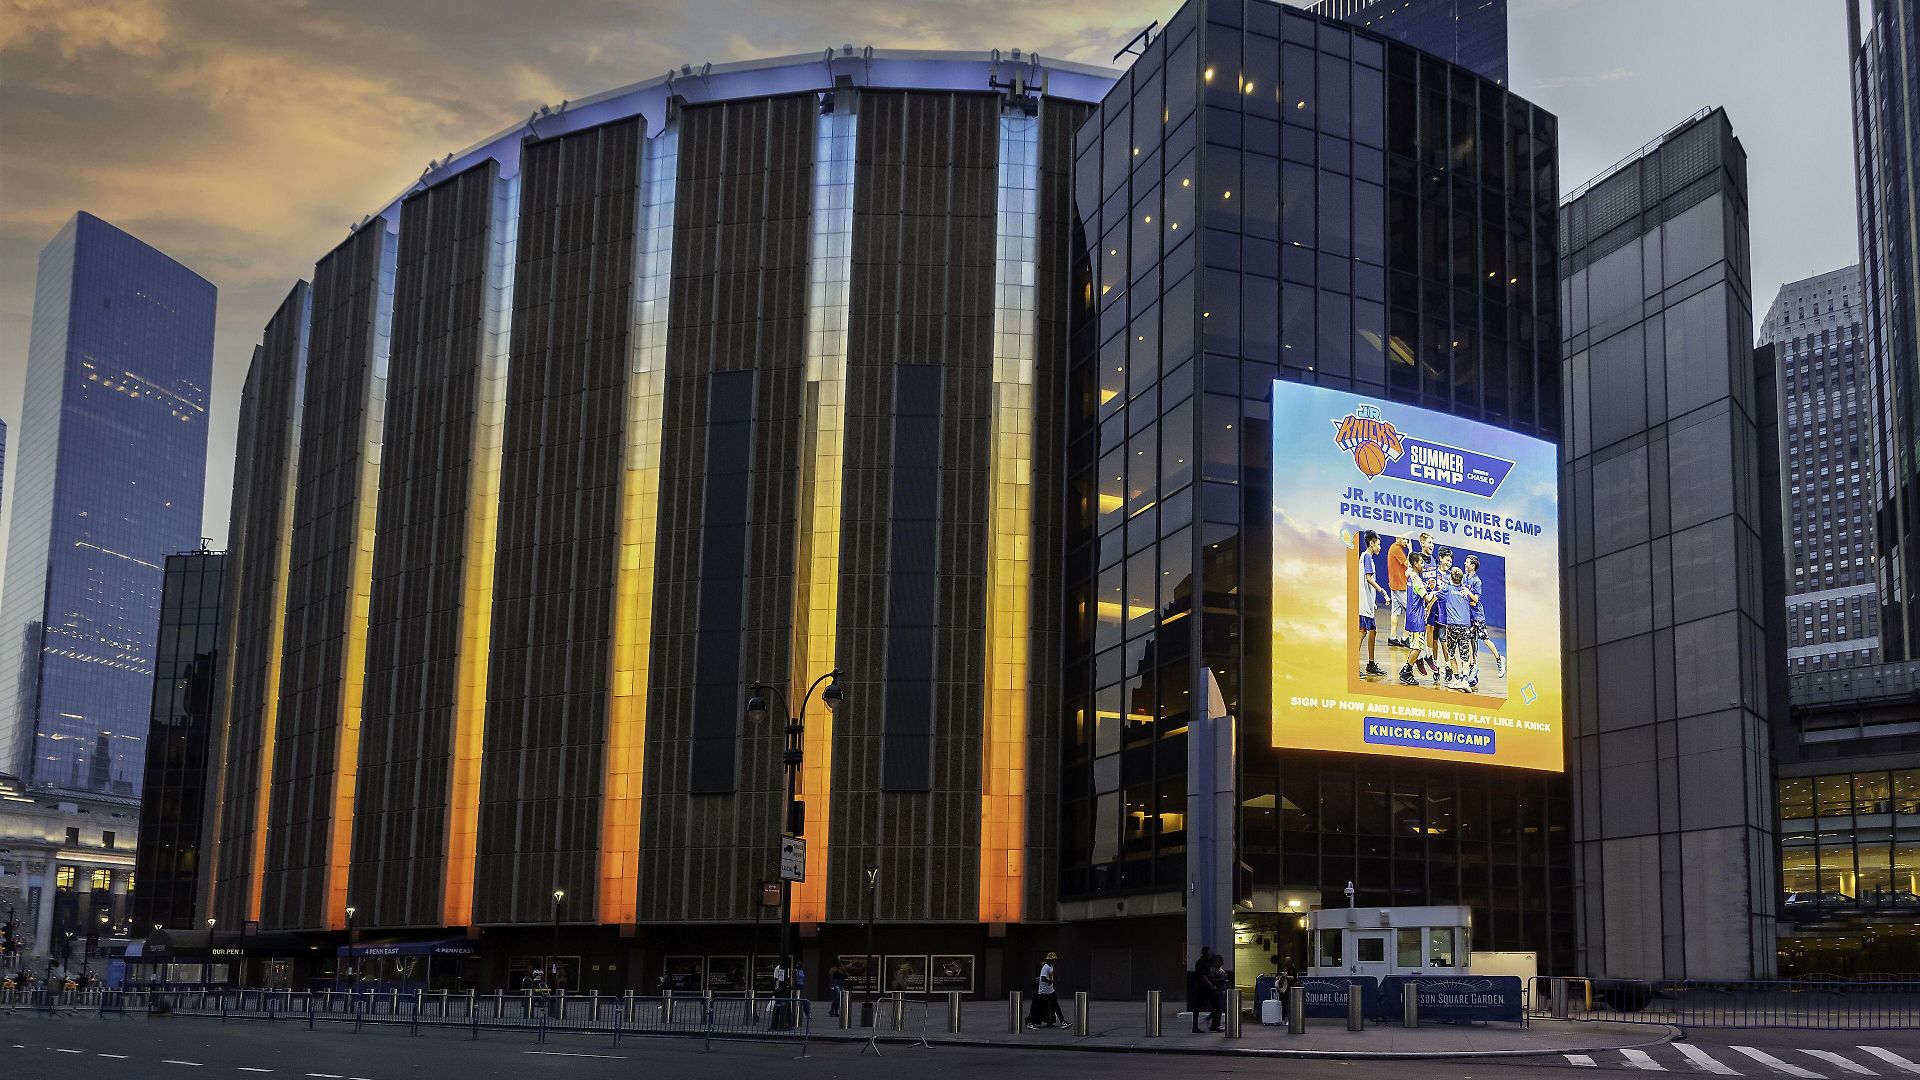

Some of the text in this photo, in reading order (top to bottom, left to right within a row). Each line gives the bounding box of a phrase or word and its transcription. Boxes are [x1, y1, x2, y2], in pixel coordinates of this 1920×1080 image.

[1357, 405, 1381, 421] JR
[1335, 414, 1404, 458] KNICKS
[1410, 445, 1464, 473] SUMMER
[1410, 463, 1464, 485] CAMP
[1467, 472, 1489, 484] CHASE
[1340, 502, 1511, 545] PRESENTED BY CHASE
[1342, 487, 1542, 537] JR. KNICKS SUMMER CAMP
[1290, 696, 1551, 732] SIGN UP NOW AND LEARN HOW TO PLAY LIKE A KNICK
[1369, 724, 1491, 747] KNICKS.COM/CAMP
[1305, 991, 1348, 1003] SQUARE GAR
[1438, 992, 1469, 1004] SQUARE
[1471, 993, 1504, 1005] GARDEN
